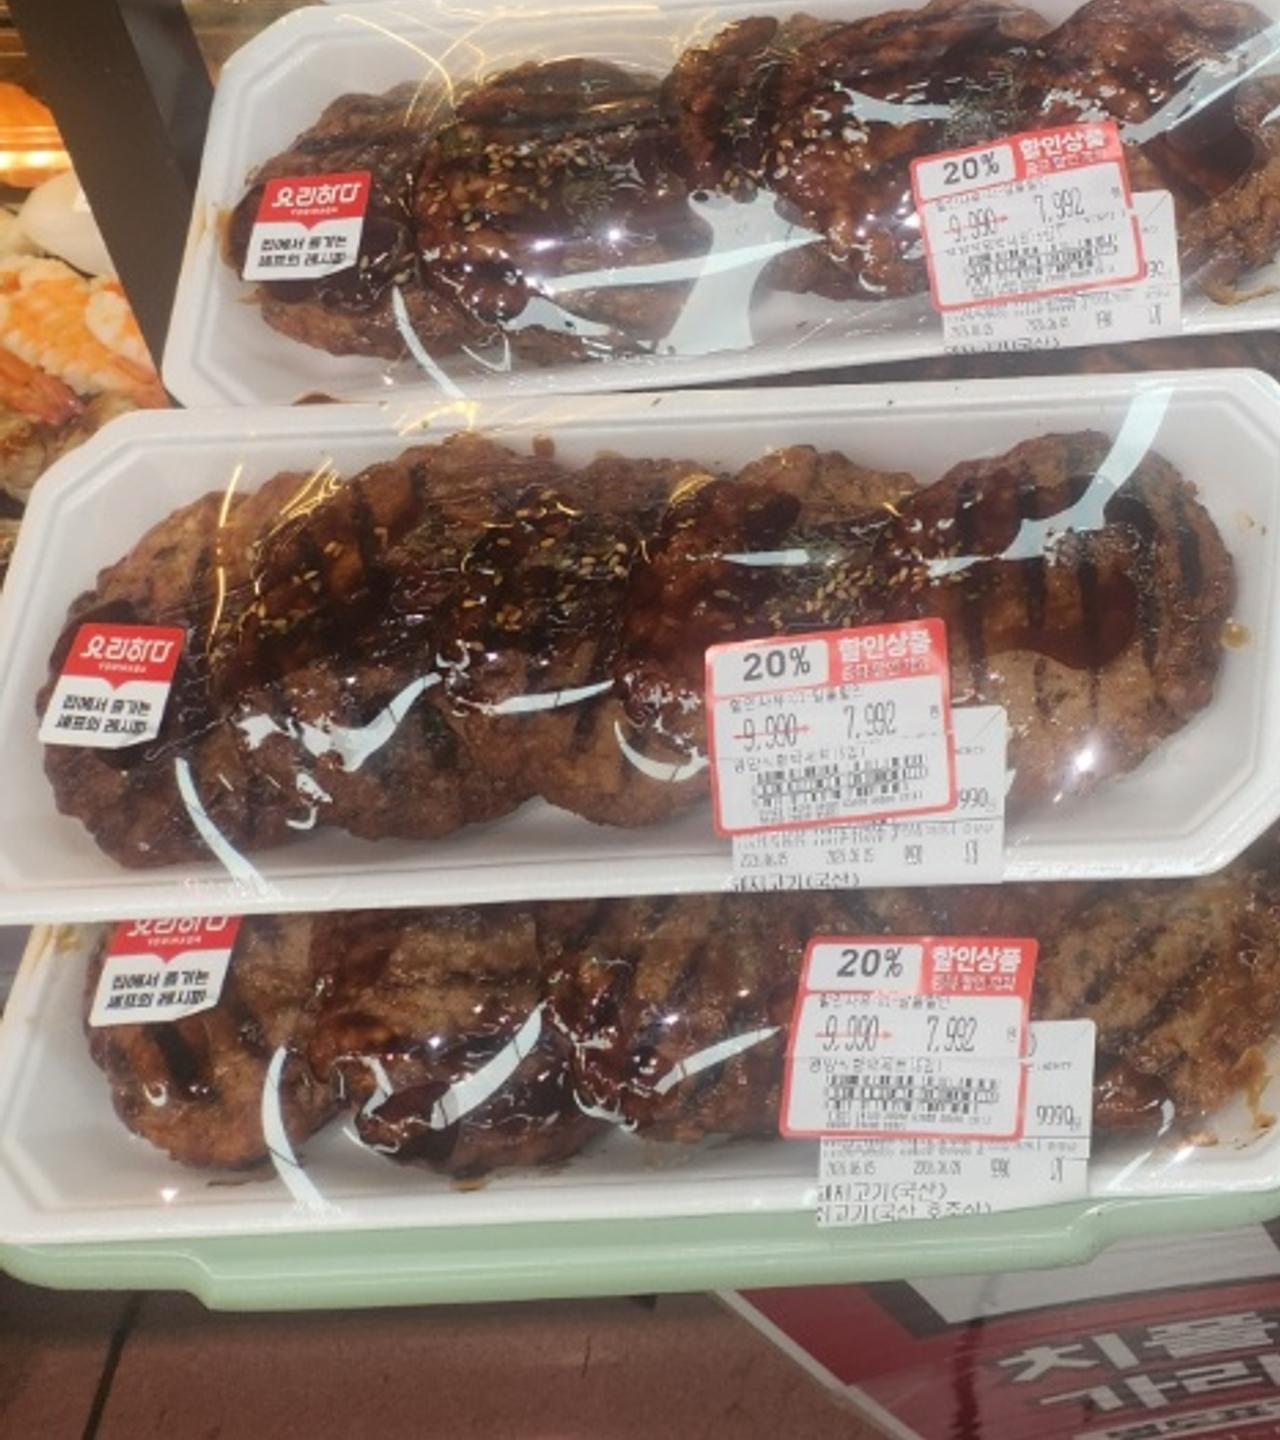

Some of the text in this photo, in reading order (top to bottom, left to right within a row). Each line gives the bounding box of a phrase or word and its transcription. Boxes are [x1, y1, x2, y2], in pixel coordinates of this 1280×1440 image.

[1019, 128, 1105, 160] 할인상품
[943, 152, 1000, 186] 20%
[271, 182, 363, 208] 요리하다
[80, 634, 175, 663] 요리하다
[837, 627, 933, 663] 할인상품
[743, 645, 811, 681] 20%
[836, 947, 903, 978] 20%
[931, 946, 1022, 974] 할인상품
[926, 1014, 978, 1053] 7,992
